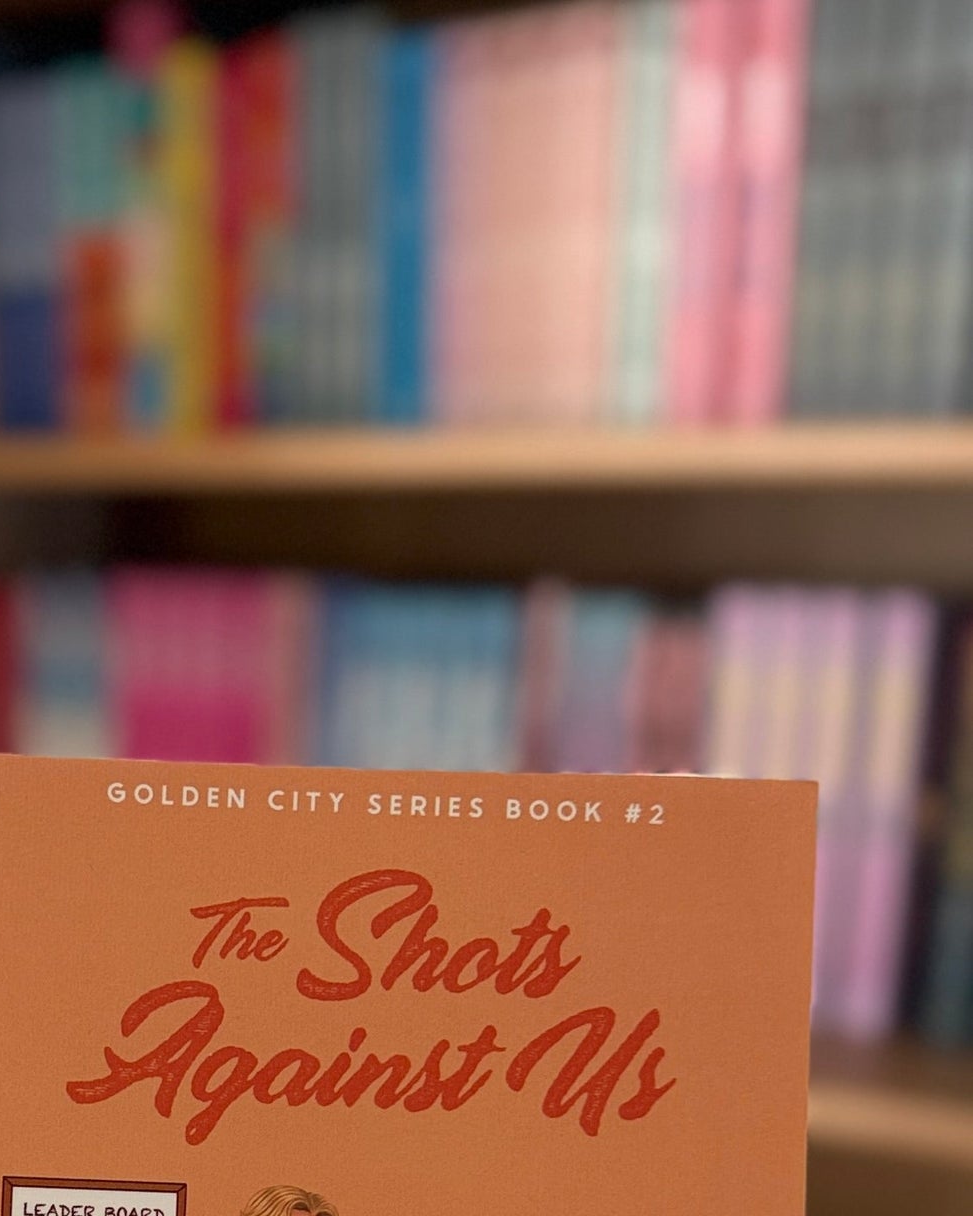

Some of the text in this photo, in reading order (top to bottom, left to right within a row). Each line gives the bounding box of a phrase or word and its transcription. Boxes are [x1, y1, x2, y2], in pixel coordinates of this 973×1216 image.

[107, 782, 666, 825] GOLDEN CITY SERIES BOOK #2
[190, 868, 582, 1001] The Shots
[66, 980, 677, 1146] Against Us
